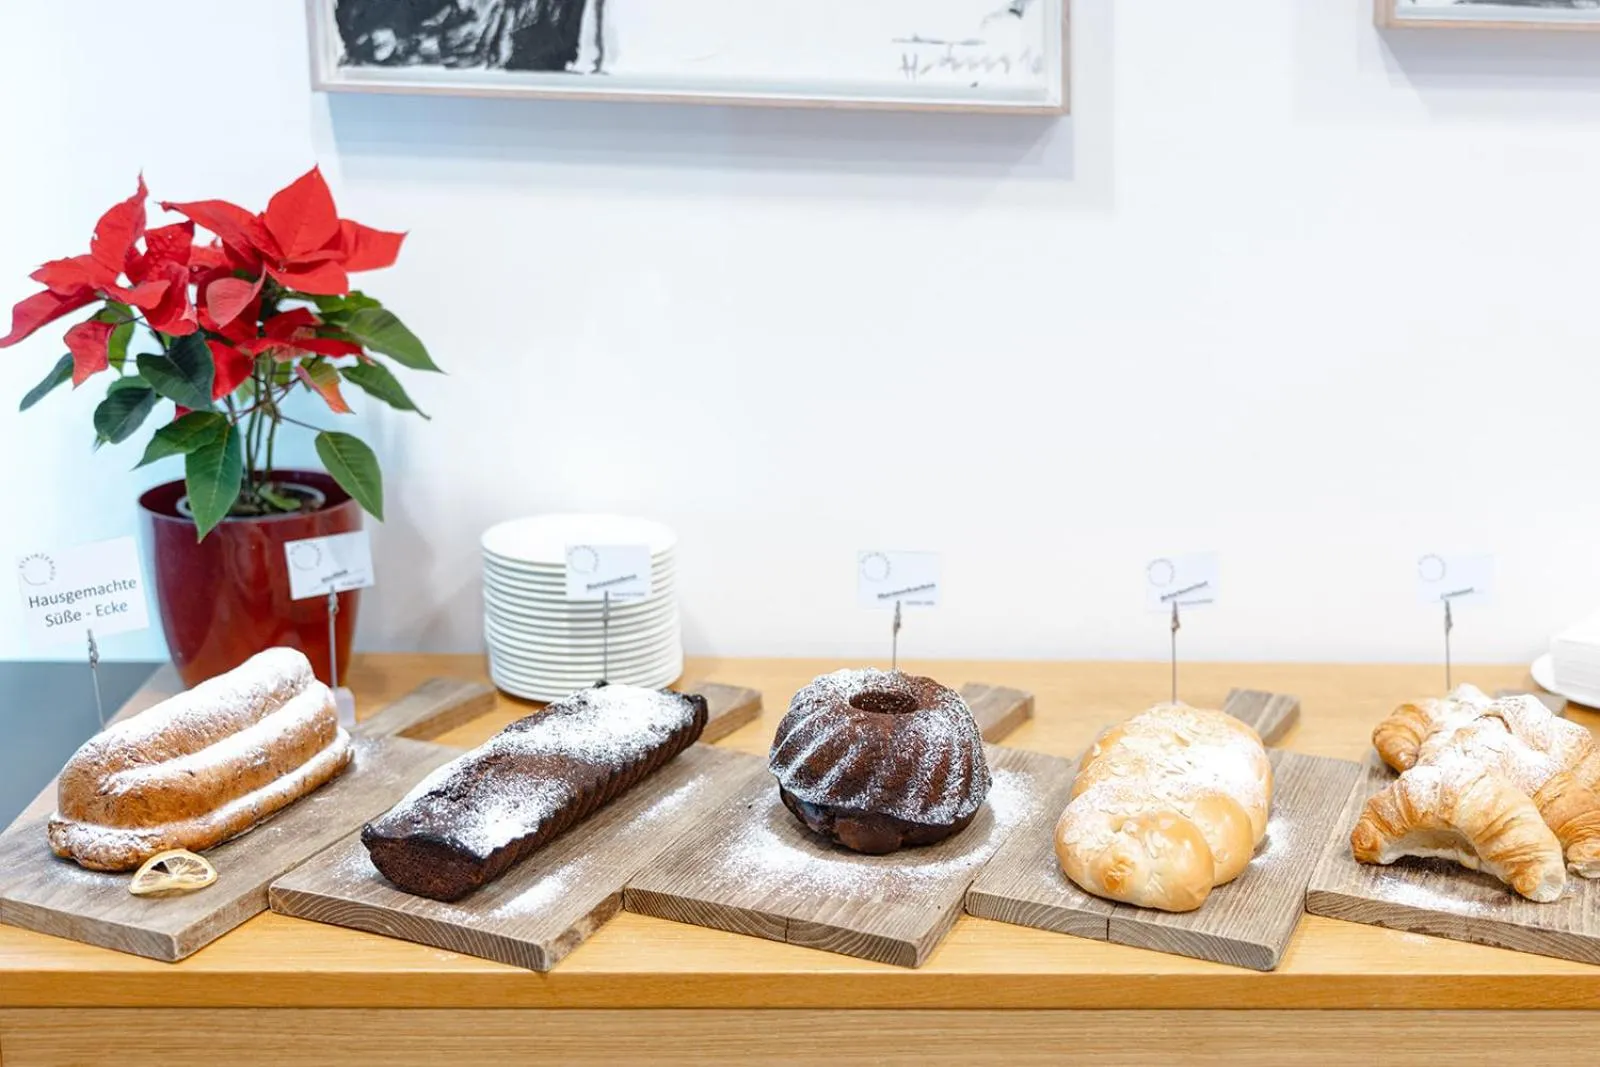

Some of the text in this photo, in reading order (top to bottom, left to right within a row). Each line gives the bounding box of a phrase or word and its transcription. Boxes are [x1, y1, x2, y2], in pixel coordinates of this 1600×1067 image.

[29, 579, 136, 608] Hausgemachte
[45, 609, 82, 627] Süße
[95, 601, 128, 617] Ecke
